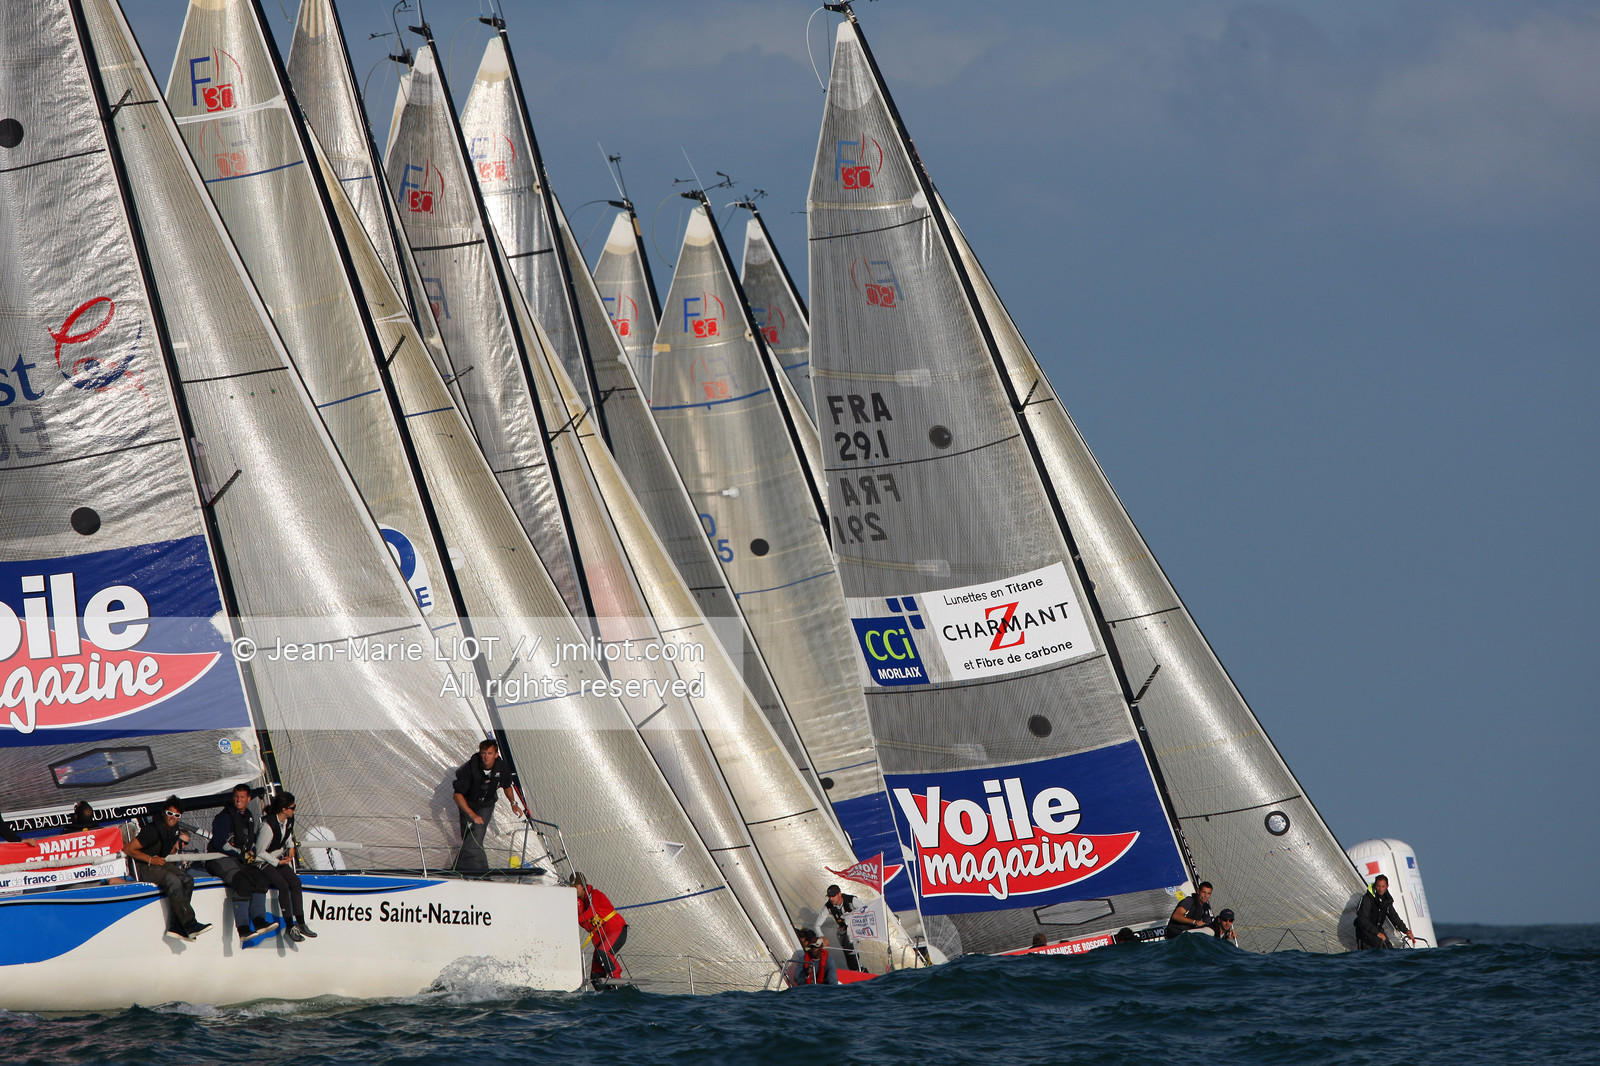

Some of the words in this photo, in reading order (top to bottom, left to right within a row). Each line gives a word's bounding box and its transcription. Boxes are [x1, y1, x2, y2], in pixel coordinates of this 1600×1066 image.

[190, 56, 211, 106] F
[203, 84, 236, 112] 30
[836, 140, 858, 181] F
[398, 163, 424, 203] F
[842, 166, 874, 189] 30
[407, 190, 433, 214] 30
[684, 297, 701, 332] F
[692, 318, 720, 338] 30
[827, 392, 893, 425] FRA
[834, 429, 889, 461] 29.1
[943, 590, 988, 606] Lunettes
[990, 586, 1005, 599] en
[1005, 577, 1044, 595] Titane
[942, 602, 1069, 642] CHARMANT
[963, 660, 975, 671] et
[976, 656, 1004, 669] Fibre
[1006, 652, 1022, 665] de
[1024, 639, 1074, 660] carbone
[877, 666, 923, 680] MORLAIX
[34, 813, 73, 829] BAULE
[893, 777, 1081, 848] Voile
[38, 834, 96, 855] NANTES
[23, 873, 58, 885] france
[73, 868, 97, 878] voile
[923, 836, 1099, 900] magazine
[310, 899, 372, 922] Nantes
[379, 900, 492, 927] Saint-Nazaire
[1072, 943, 1083, 953] DE
[1082, 938, 1109, 952] ROSCOFF
